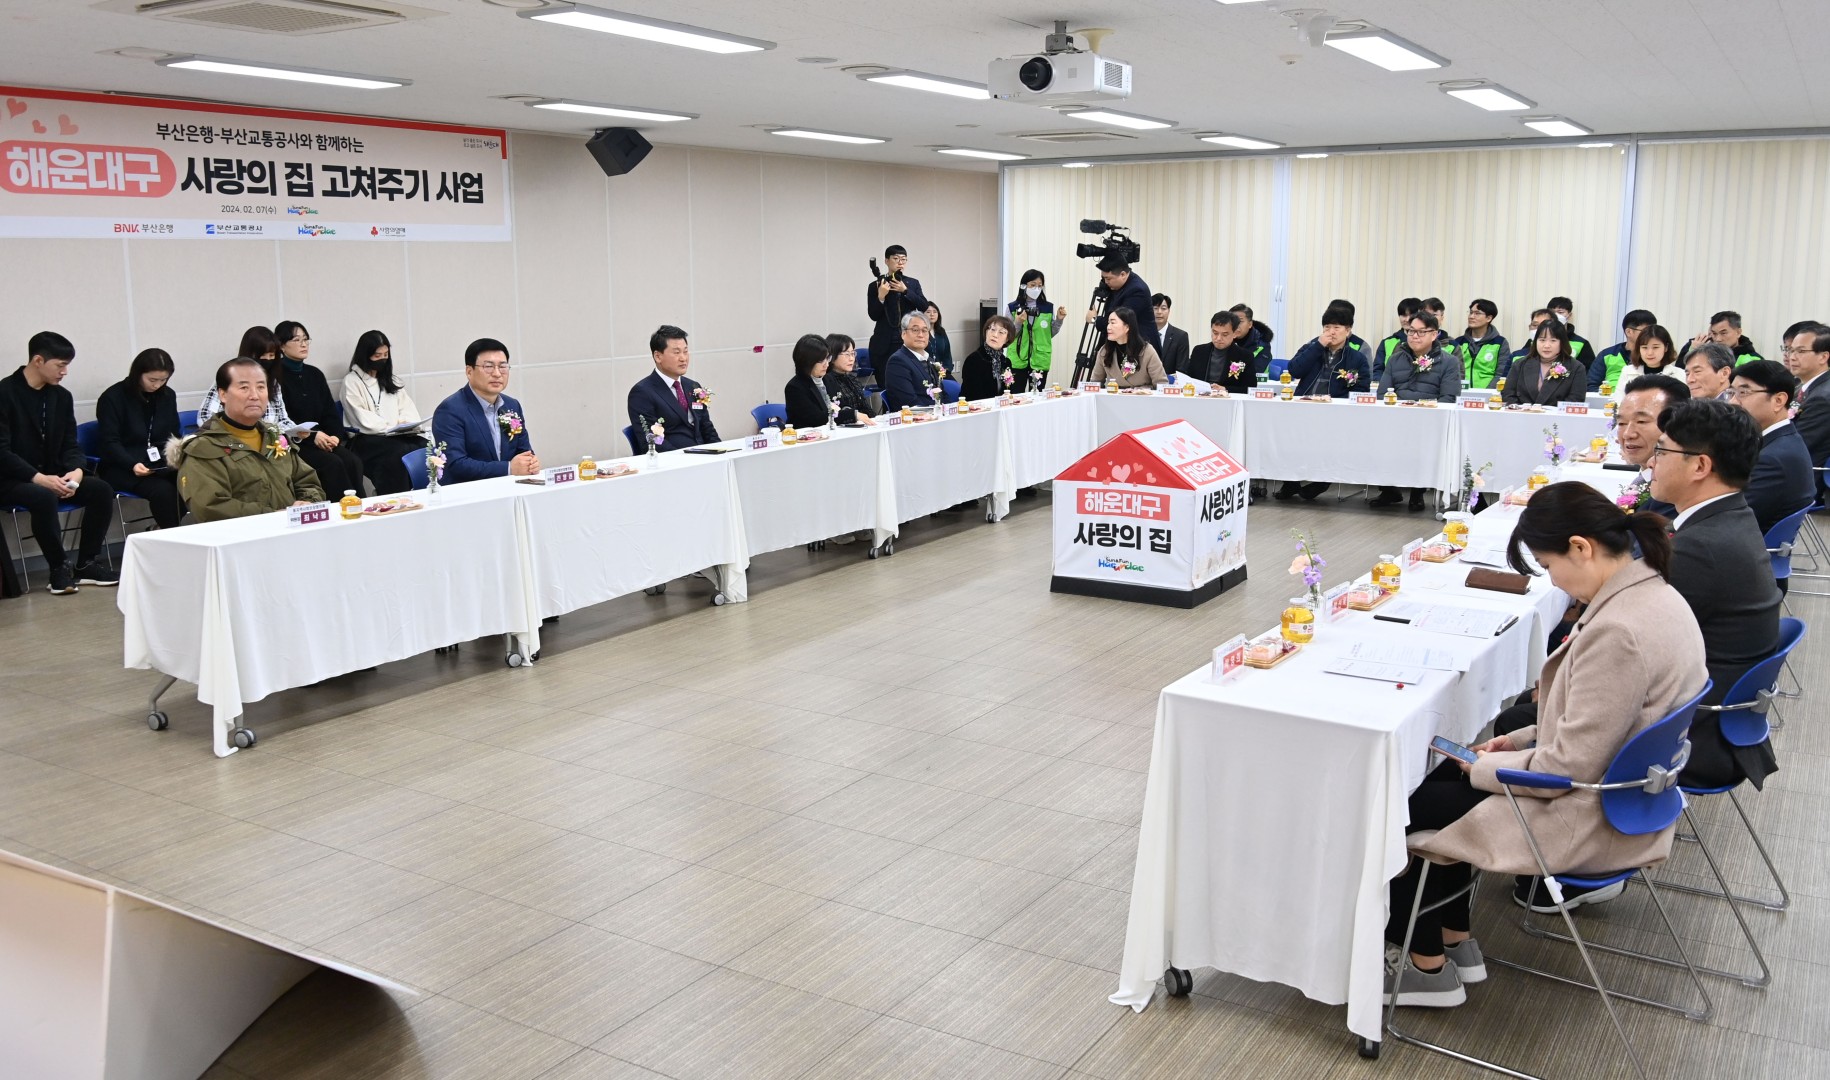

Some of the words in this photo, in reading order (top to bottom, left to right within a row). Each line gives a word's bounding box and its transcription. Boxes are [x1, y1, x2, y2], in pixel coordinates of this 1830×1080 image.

[156, 123, 312, 149] 부산은행-부산교통공사와
[315, 134, 364, 153] 함께하는
[6, 146, 161, 193] 해운대구
[181, 157, 277, 196] 사랑의
[284, 162, 315, 197] 집
[321, 164, 429, 202] 고쳐주기
[436, 171, 484, 204] 사업
[114, 223, 140, 233] BNK
[141, 223, 174, 234] 부산은행
[1182, 456, 1232, 482] 해운대구
[1084, 491, 1162, 517] 해운대구
[1200, 485, 1235, 524] 사랑의
[1237, 479, 1246, 511] 집
[1073, 522, 1142, 550] 사랑의
[1149, 527, 1172, 555] 집
